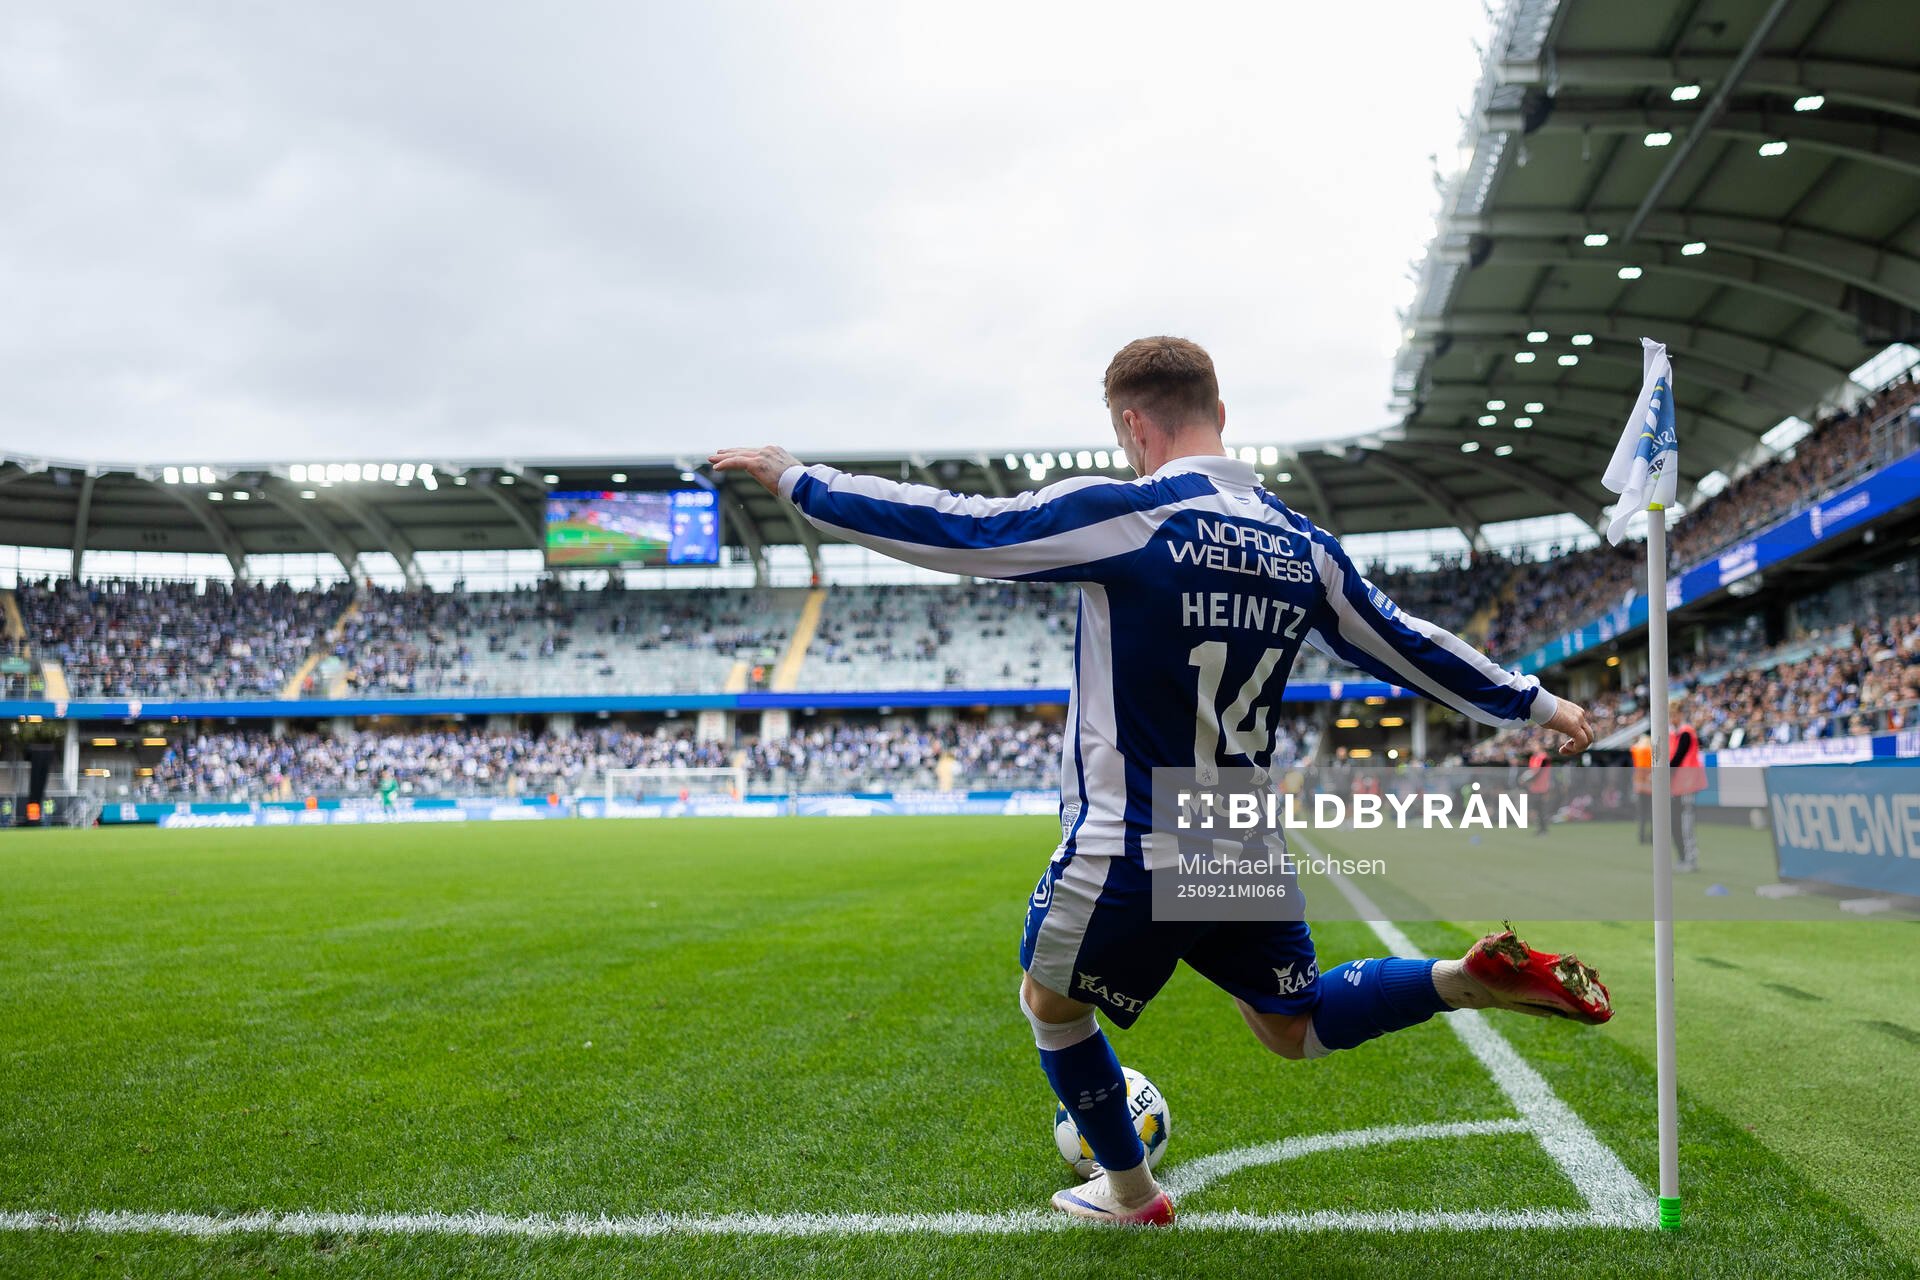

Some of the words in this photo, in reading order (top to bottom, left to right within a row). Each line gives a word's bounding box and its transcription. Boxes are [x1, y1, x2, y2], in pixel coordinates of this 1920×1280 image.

[1197, 518, 1294, 557] NORDIC
[1166, 540, 1313, 584] WELLNESS
[1181, 591, 1307, 640] HEINTZ
[1188, 640, 1284, 786] 14
[1078, 978, 1145, 1014] RAST
[1130, 1085, 1157, 1122] LECT
